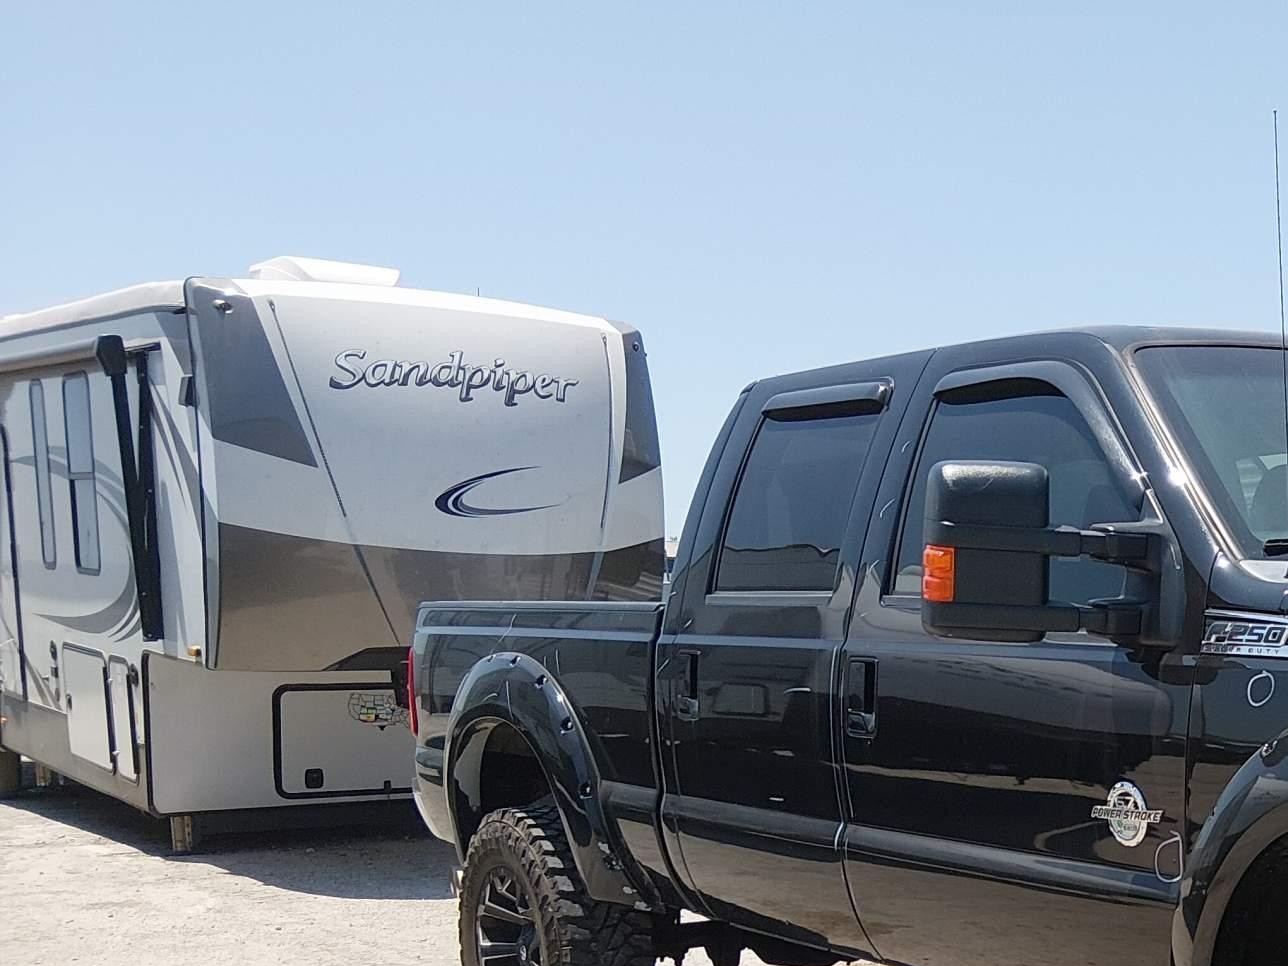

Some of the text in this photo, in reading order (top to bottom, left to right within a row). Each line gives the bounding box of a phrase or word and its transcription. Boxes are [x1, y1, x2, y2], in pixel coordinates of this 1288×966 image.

[329, 349, 579, 407] Sandpiper
[1091, 807, 1161, 822] POWER STROKE
